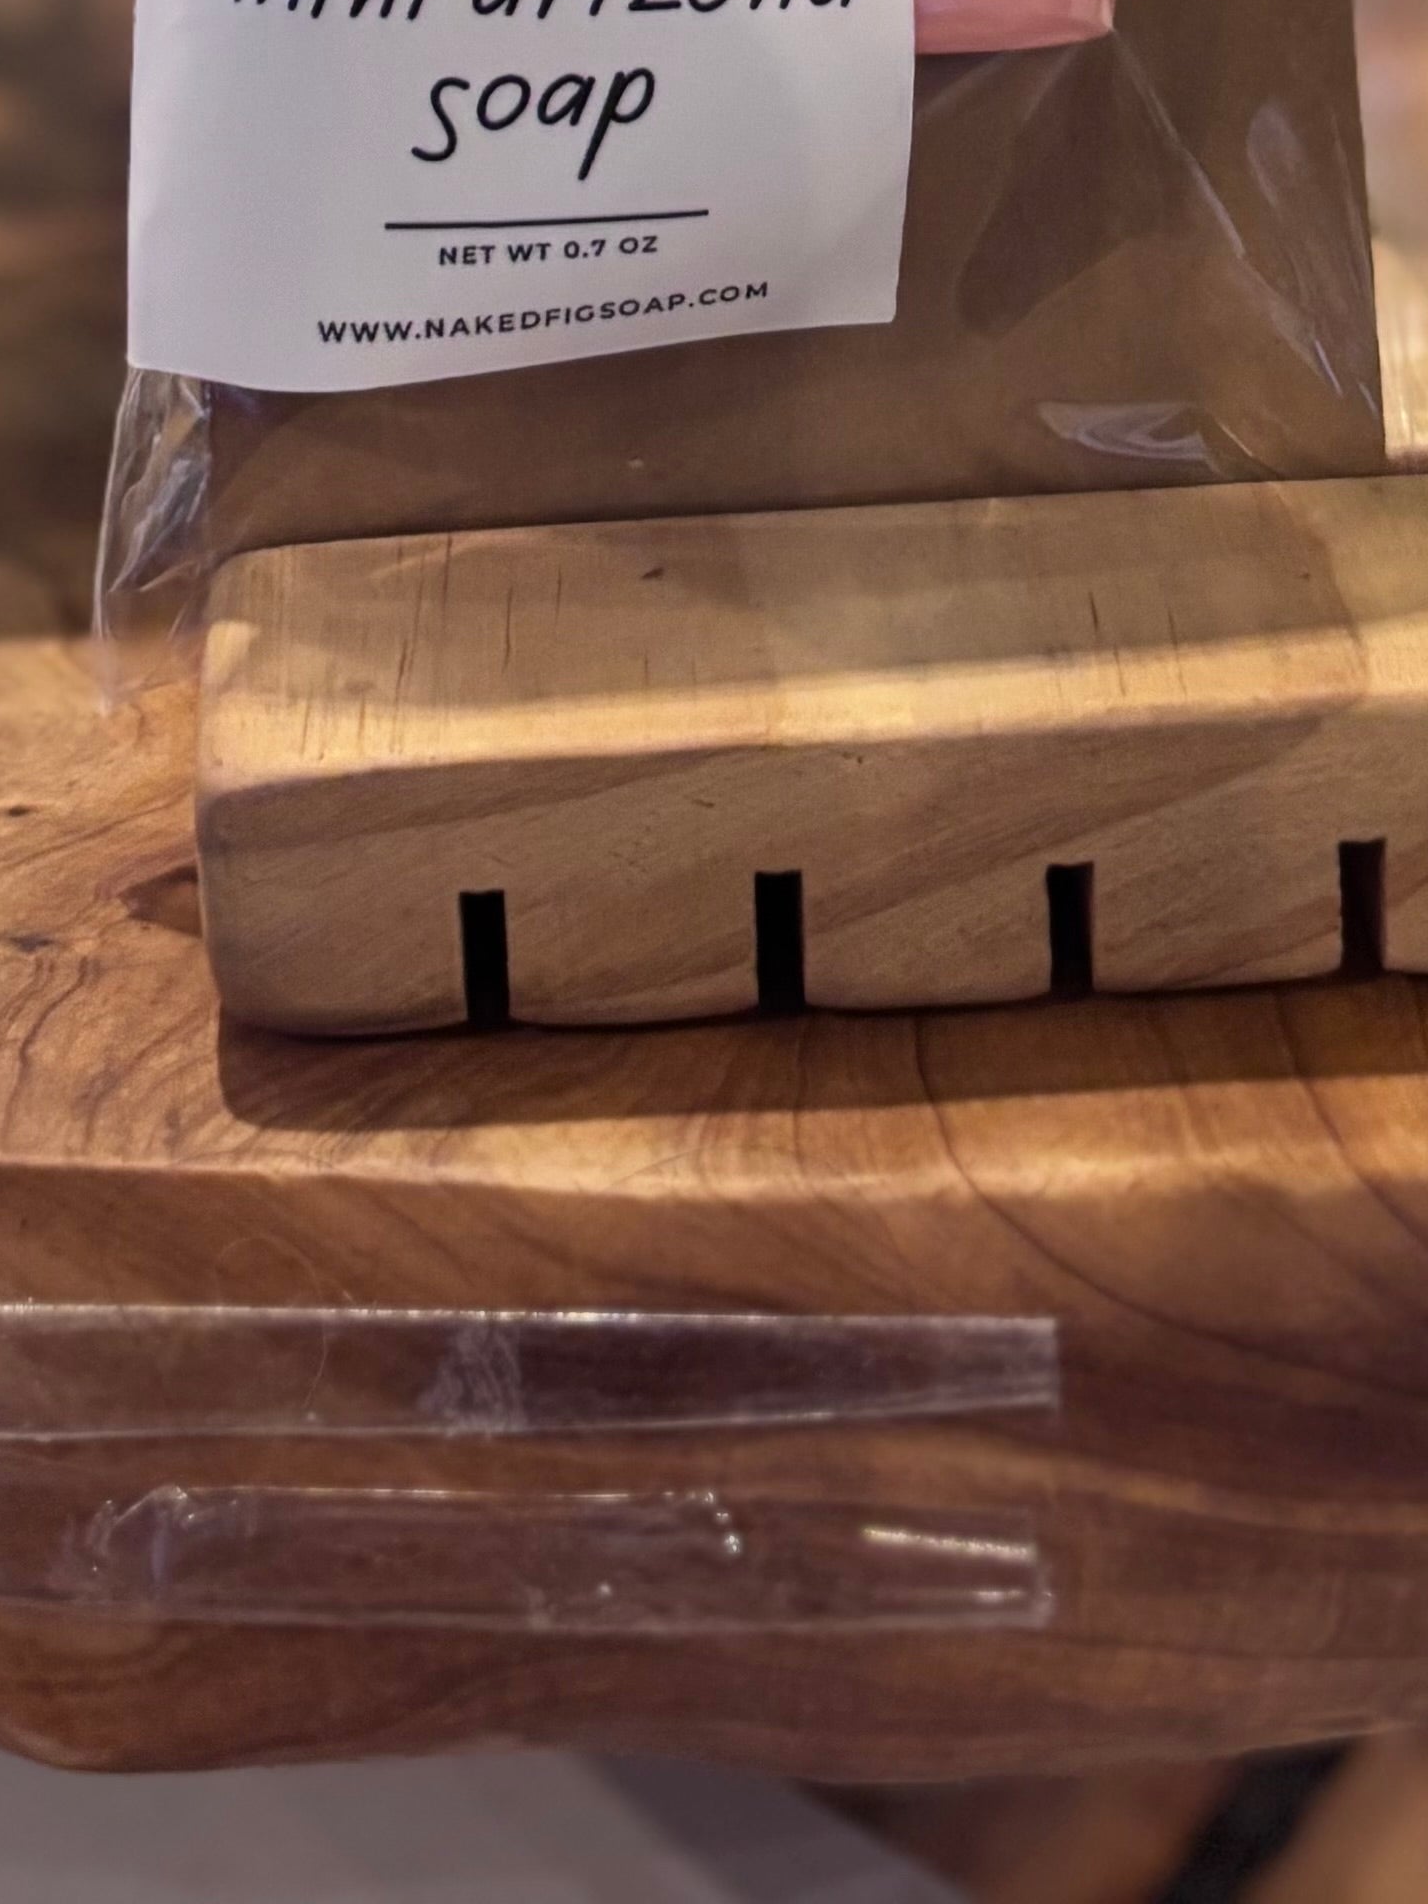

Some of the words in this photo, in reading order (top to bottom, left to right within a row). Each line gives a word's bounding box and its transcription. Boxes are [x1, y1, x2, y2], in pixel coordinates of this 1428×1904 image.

[410, 66, 656, 182] soap
[438, 244, 497, 267] NET
[506, 242, 552, 264] WT
[563, 238, 607, 260] 0.7
[618, 235, 658, 255] OZ
[317, 281, 768, 344] WWW.NAKEDFIGSOAP.COM
